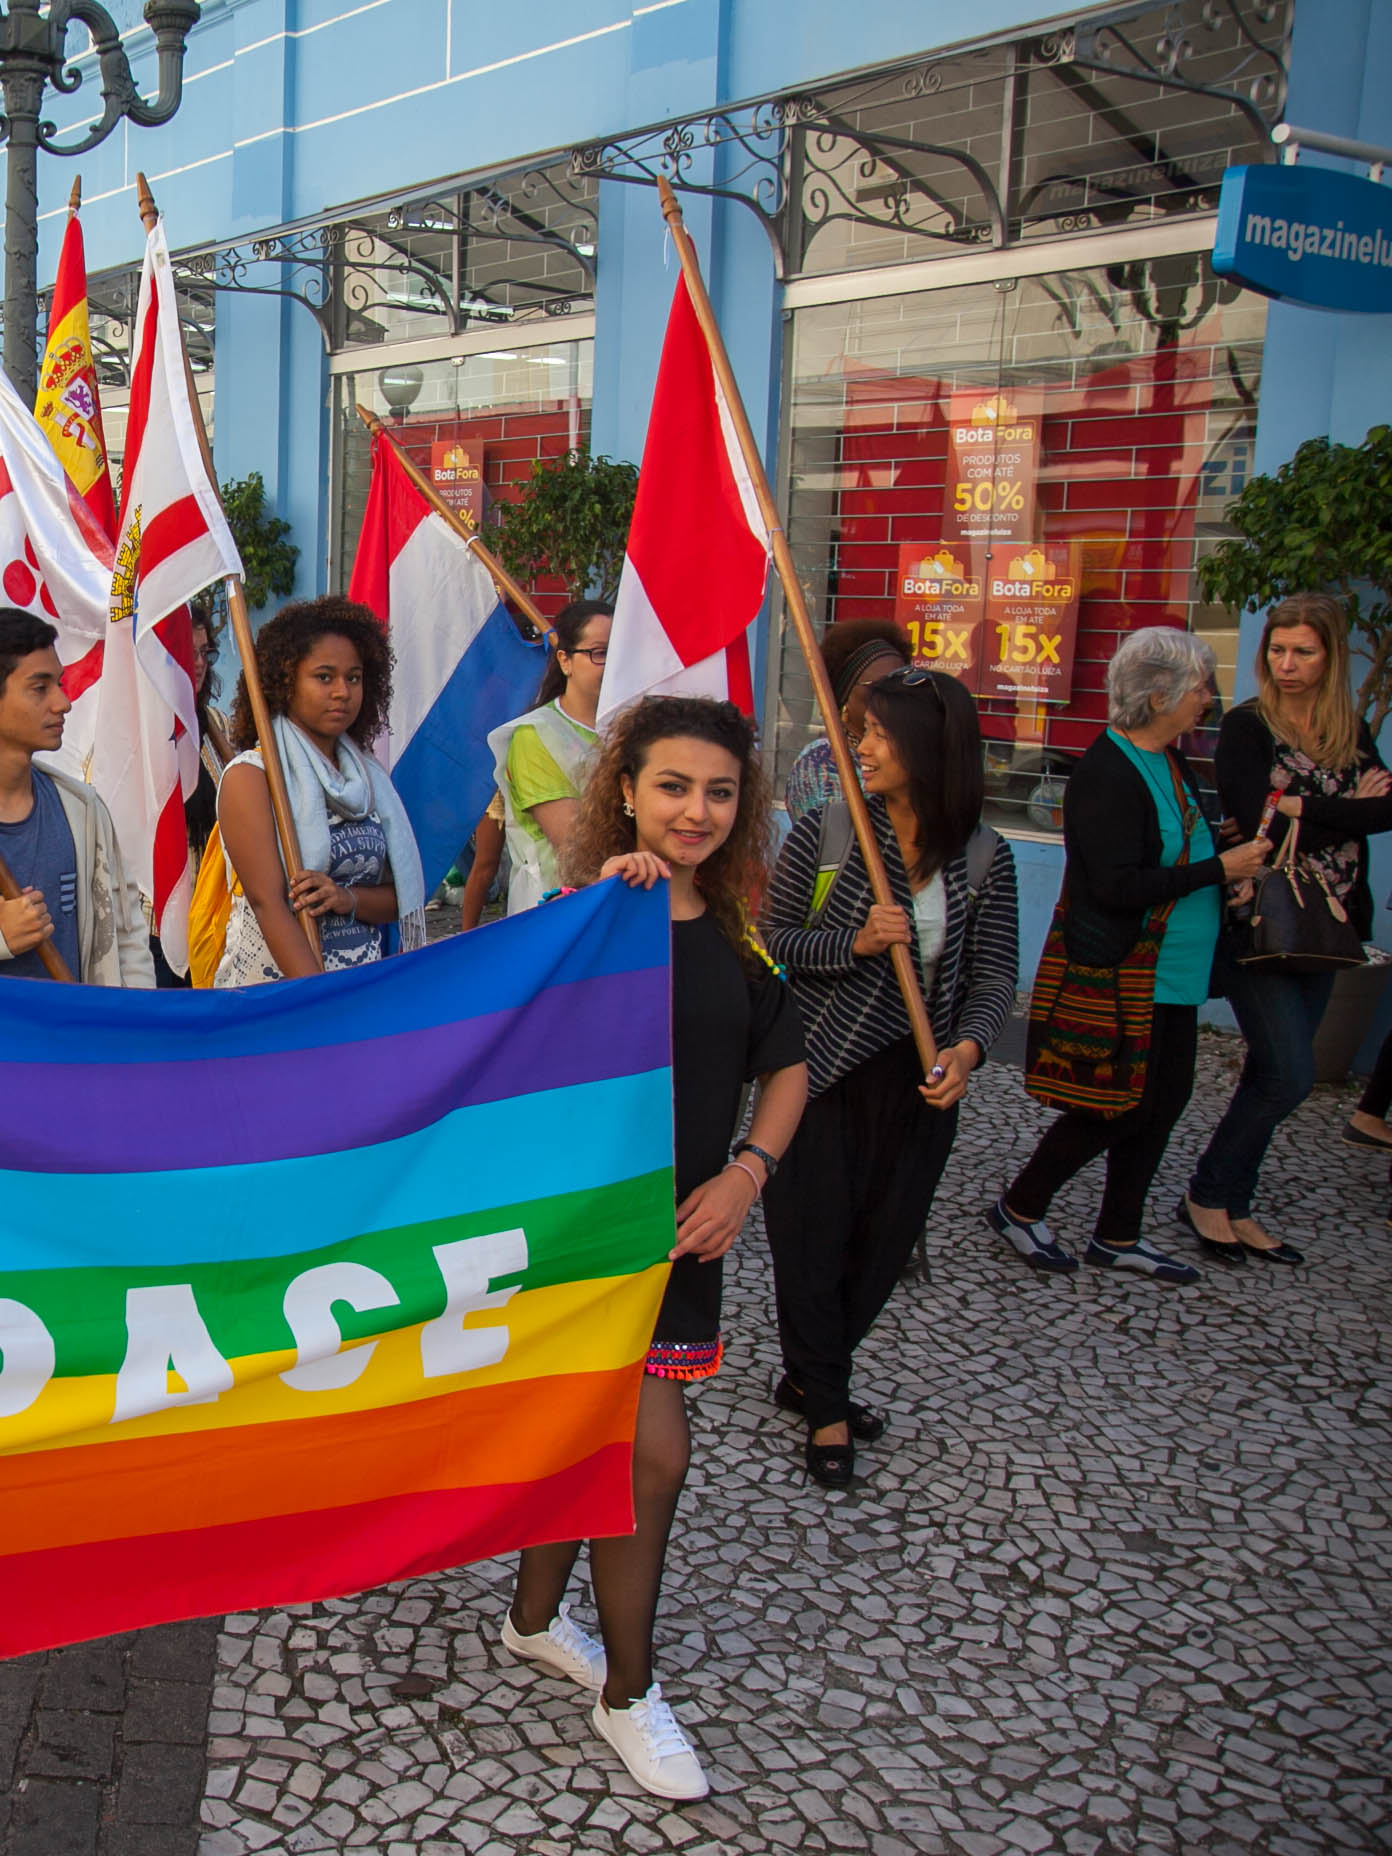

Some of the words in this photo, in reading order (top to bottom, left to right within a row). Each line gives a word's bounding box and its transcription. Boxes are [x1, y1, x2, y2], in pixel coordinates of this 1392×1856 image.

[962, 453, 1021, 465] PRODUTOS
[967, 468, 992, 478] COM
[994, 466, 1014, 477] ATÉ
[953, 481, 1024, 511] 50%
[956, 514, 969, 522] DE
[914, 604, 921, 612] A
[921, 604, 941, 612] LOJA
[942, 604, 965, 613] TODA
[1003, 606, 1010, 614] A
[1011, 606, 1032, 615] LOJA
[1034, 607, 1057, 616] TODA
[906, 621, 968, 659] 15x
[995, 624, 1062, 664] 15x
